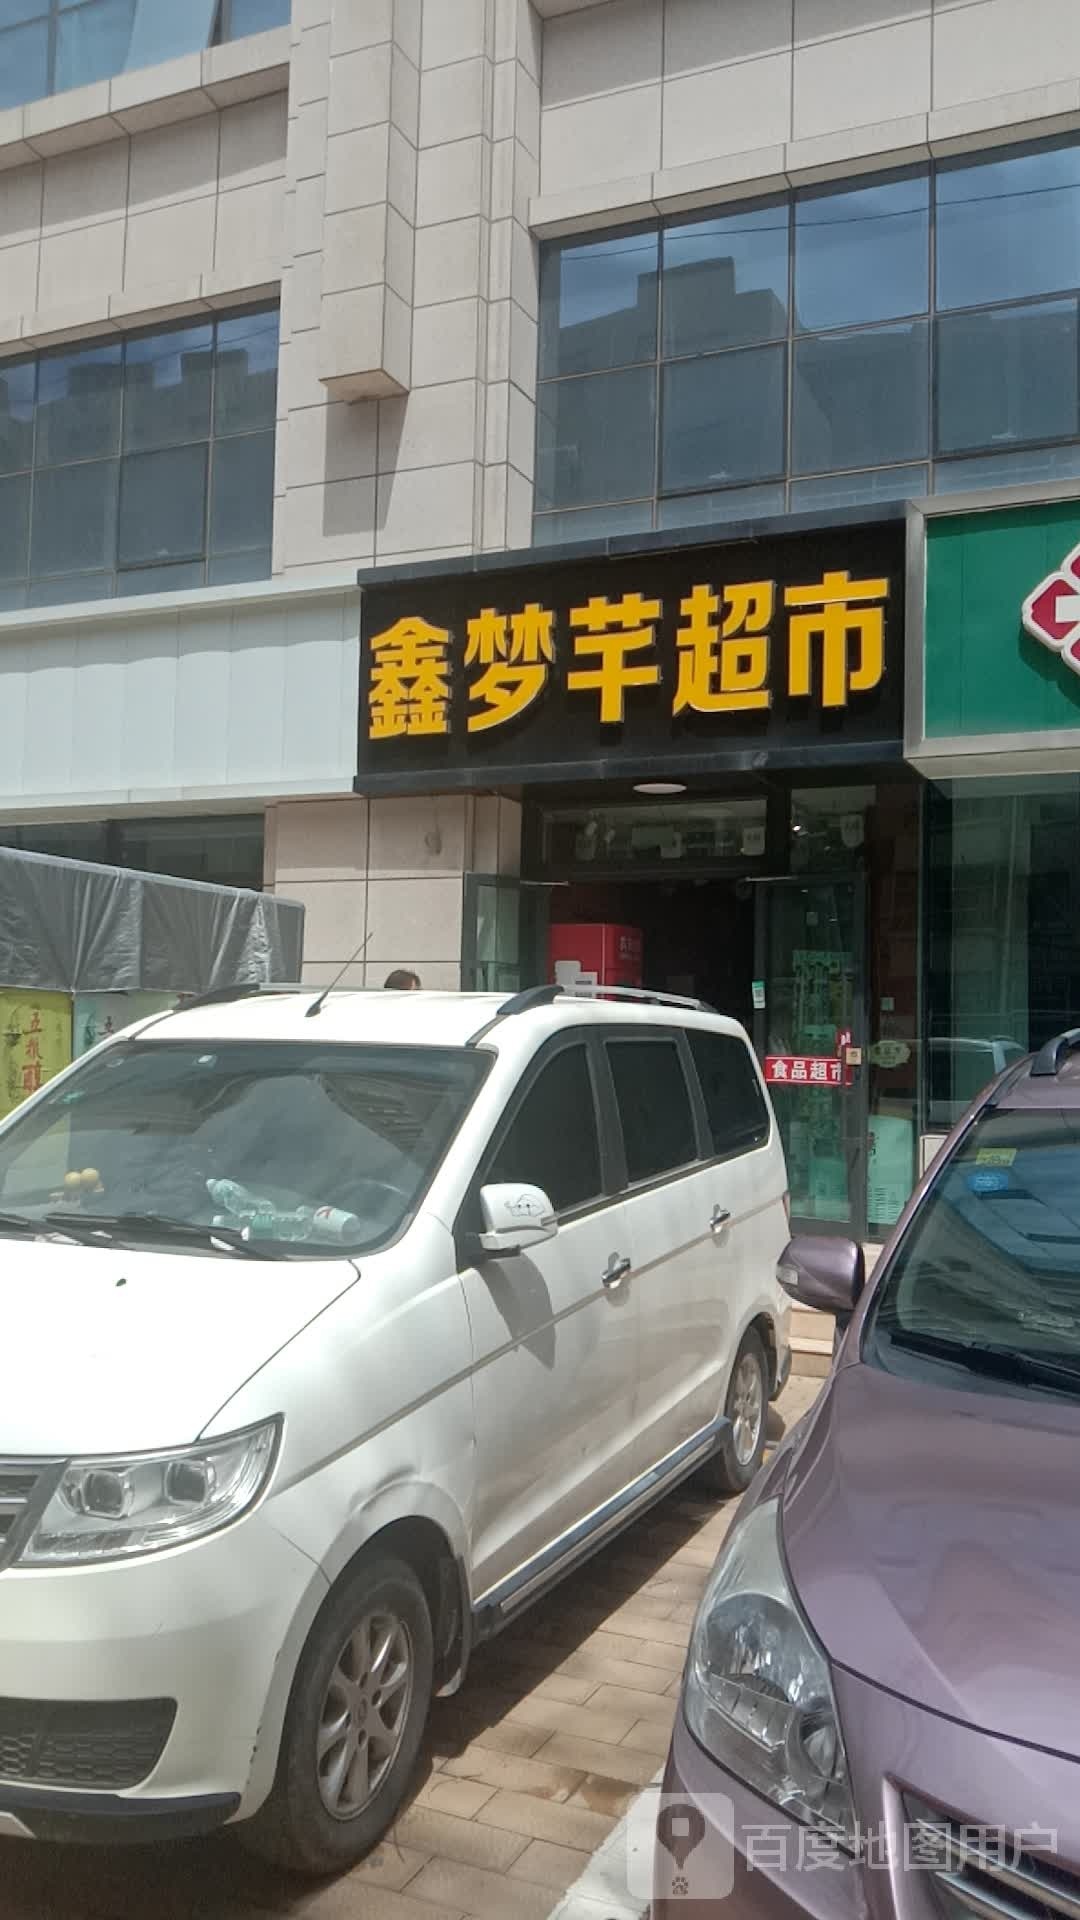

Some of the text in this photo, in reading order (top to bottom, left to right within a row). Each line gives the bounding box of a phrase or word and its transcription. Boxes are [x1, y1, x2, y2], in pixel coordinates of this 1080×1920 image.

[368, 571, 889, 739] 鑫梦芊超市
[771, 1060, 842, 1081] 食品超市
